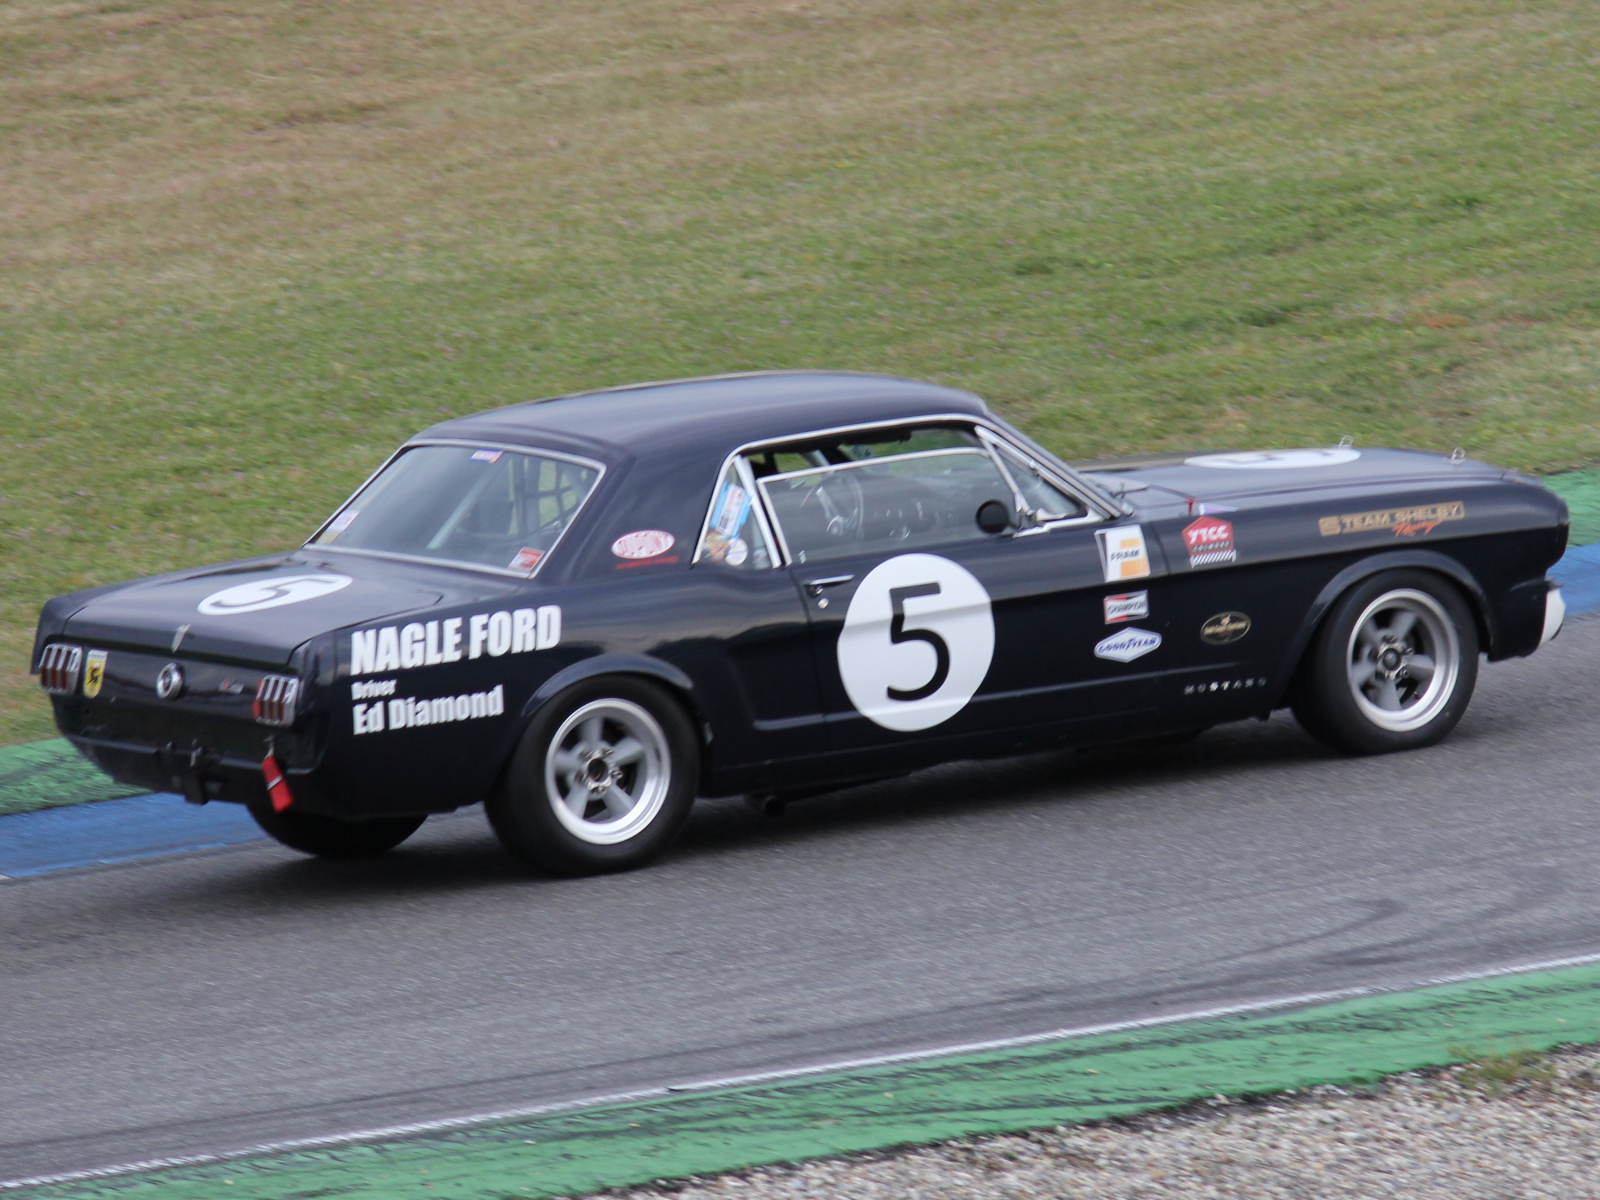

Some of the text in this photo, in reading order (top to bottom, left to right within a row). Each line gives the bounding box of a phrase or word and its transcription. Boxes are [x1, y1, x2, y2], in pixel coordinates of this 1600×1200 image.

[1341, 513, 1391, 530] TEAM
[1394, 503, 1461, 523] SHELBY
[1187, 524, 1230, 545] YTCC
[1110, 548, 1141, 562] FRAM
[209, 578, 336, 608] 5
[1107, 599, 1147, 616] CHAMPION
[351, 605, 562, 676] NAGLE FORD
[886, 582, 951, 701] 5
[1098, 636, 1158, 654] GOODYEAR
[351, 679, 397, 700] Driver
[1183, 677, 1267, 695] MUSTANG
[353, 684, 504, 735] Ed Diamond
